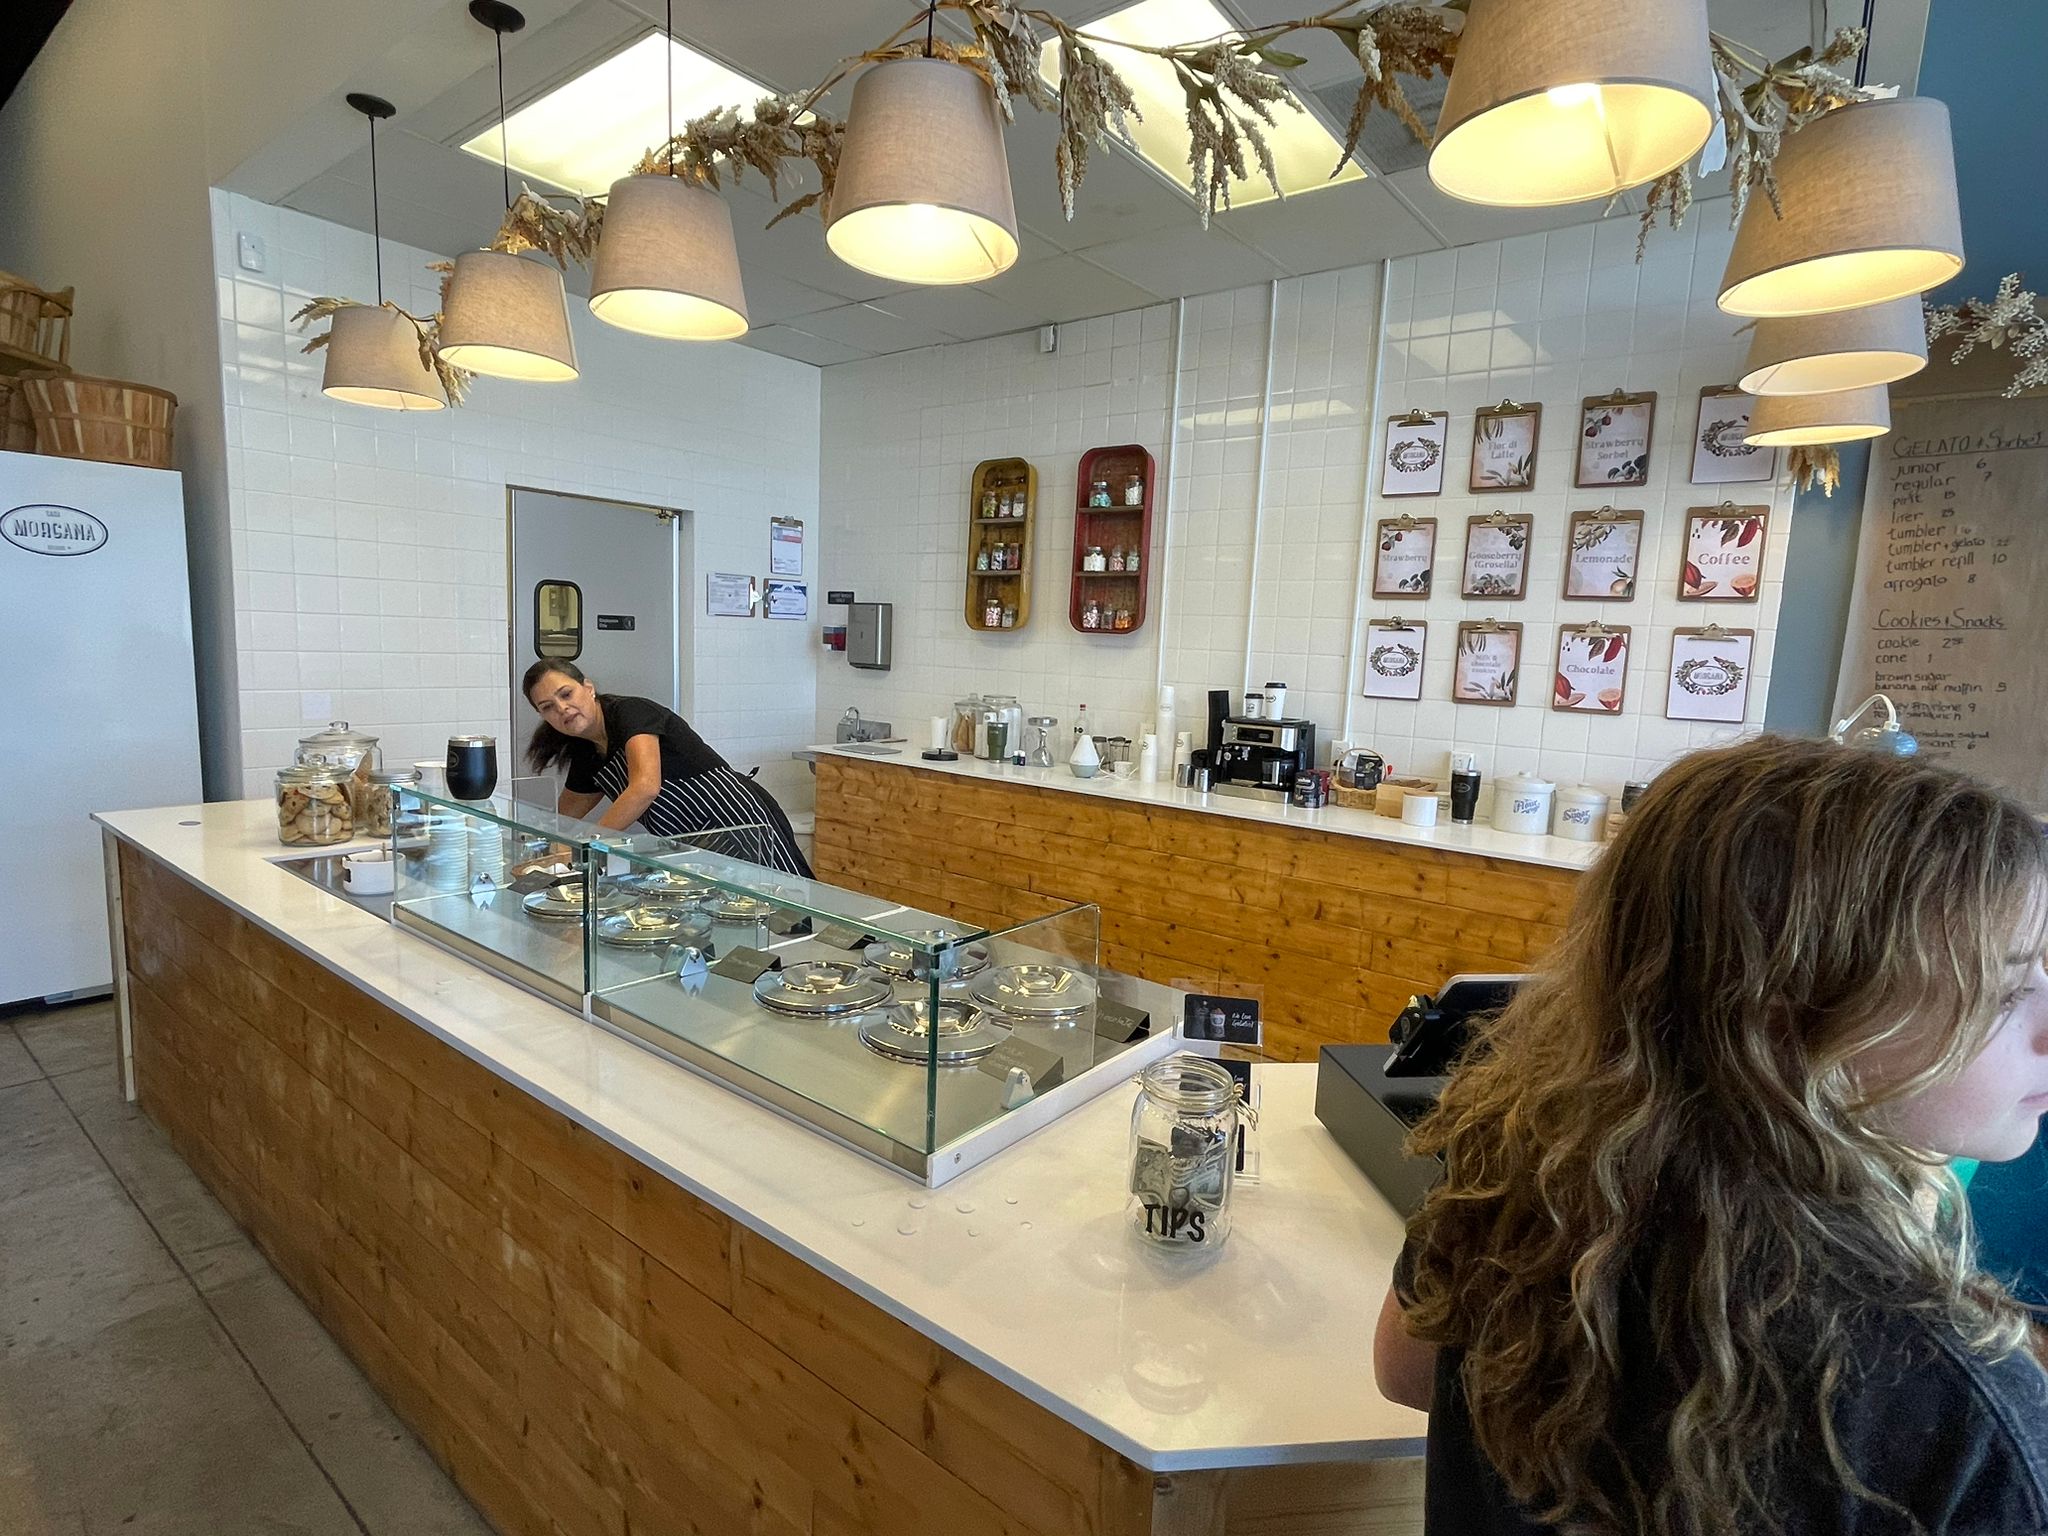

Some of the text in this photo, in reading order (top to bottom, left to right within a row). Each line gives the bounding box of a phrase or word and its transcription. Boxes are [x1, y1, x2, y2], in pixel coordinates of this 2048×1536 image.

[1488, 441, 1505, 450] Flor
[1585, 438, 1643, 449] Strawberry
[1893, 435, 1970, 457] GELATO
[1491, 451, 1515, 460] Latte
[1597, 450, 1628, 460] Sorbet
[1976, 457, 1986, 469] 6
[1894, 471, 1992, 494] regular 7
[13, 519, 96, 541] MORGANA
[1887, 523, 1946, 540] tumbler
[1888, 539, 1941, 556] tumbler
[1950, 537, 1985, 553] gelato
[1382, 554, 1428, 562] Strawberry
[1469, 551, 1522, 561] Gooseberry
[1575, 553, 1633, 564] Lemonade
[1698, 552, 1751, 566] Coffee
[1887, 551, 2007, 574] tumbler refill 10
[1474, 560, 1518, 569] (Grosella)
[1878, 608, 1941, 628] Cookies
[1950, 607, 2005, 629] Snacks
[1877, 635, 1921, 650] cookie
[1875, 653, 1907, 664] cone
[1566, 664, 1615, 675] Chocolate
[1875, 671, 1951, 684] brown sugar
[1875, 683, 1917, 691] banana
[1944, 682, 1983, 695] muffin
[1562, 808, 1591, 824] Sugar
[1144, 1204, 1205, 1242] TIPS
